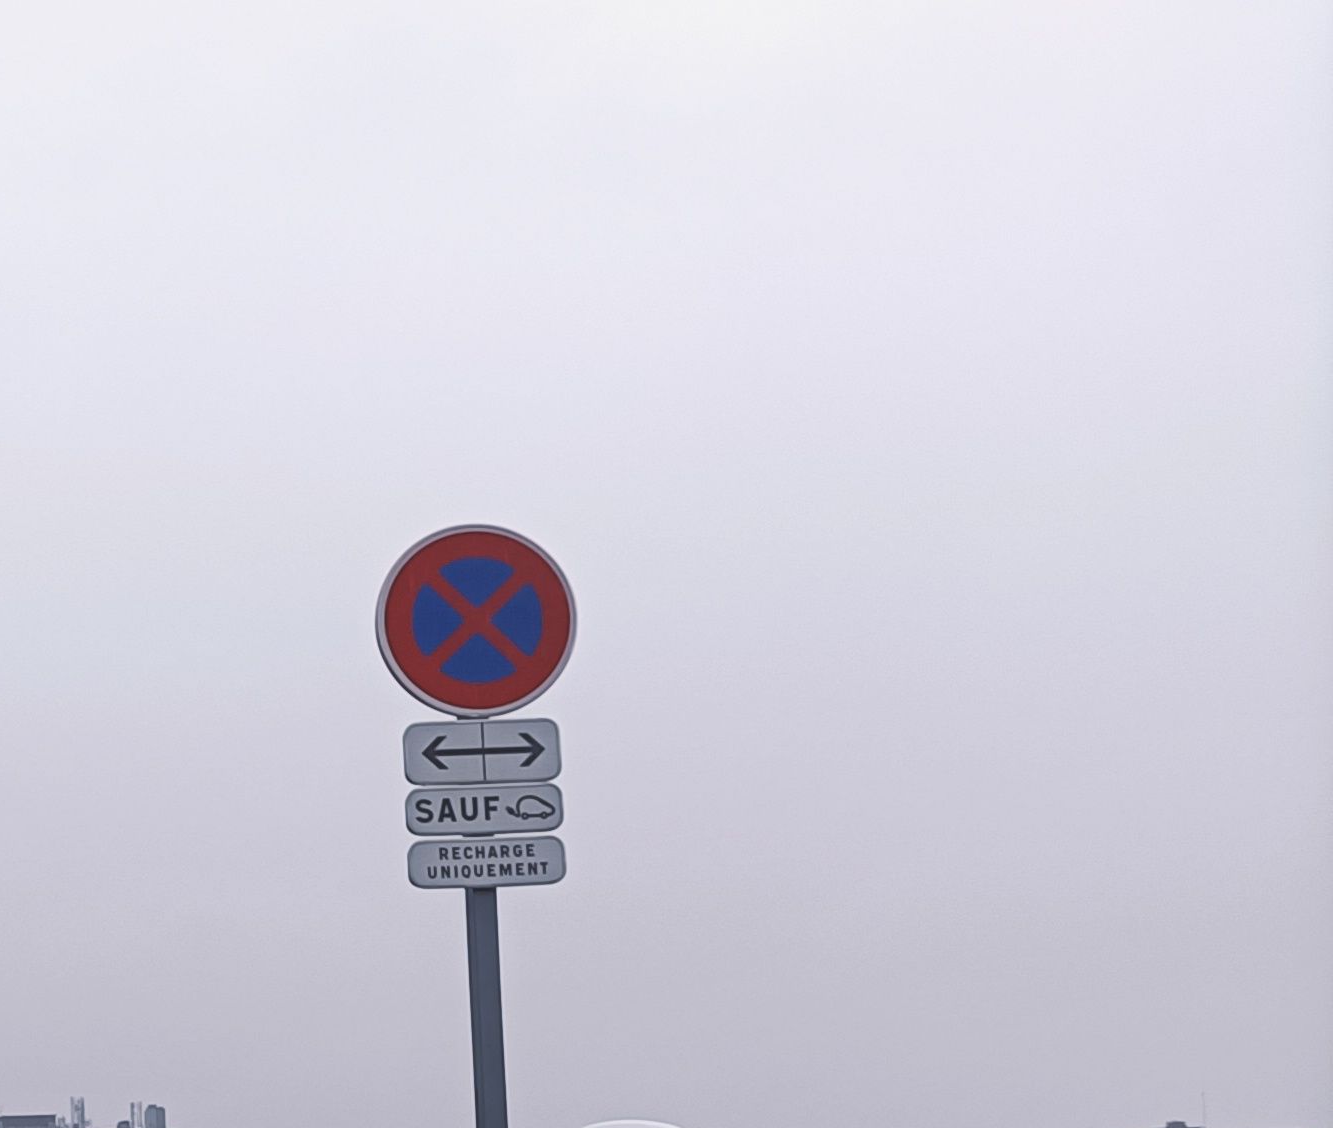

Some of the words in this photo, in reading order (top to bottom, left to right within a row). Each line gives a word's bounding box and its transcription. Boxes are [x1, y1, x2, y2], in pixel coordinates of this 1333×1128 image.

[415, 795, 500, 824] SAUF
[438, 843, 536, 861] RECHARGE
[427, 861, 549, 880] UNIQUEMENT
